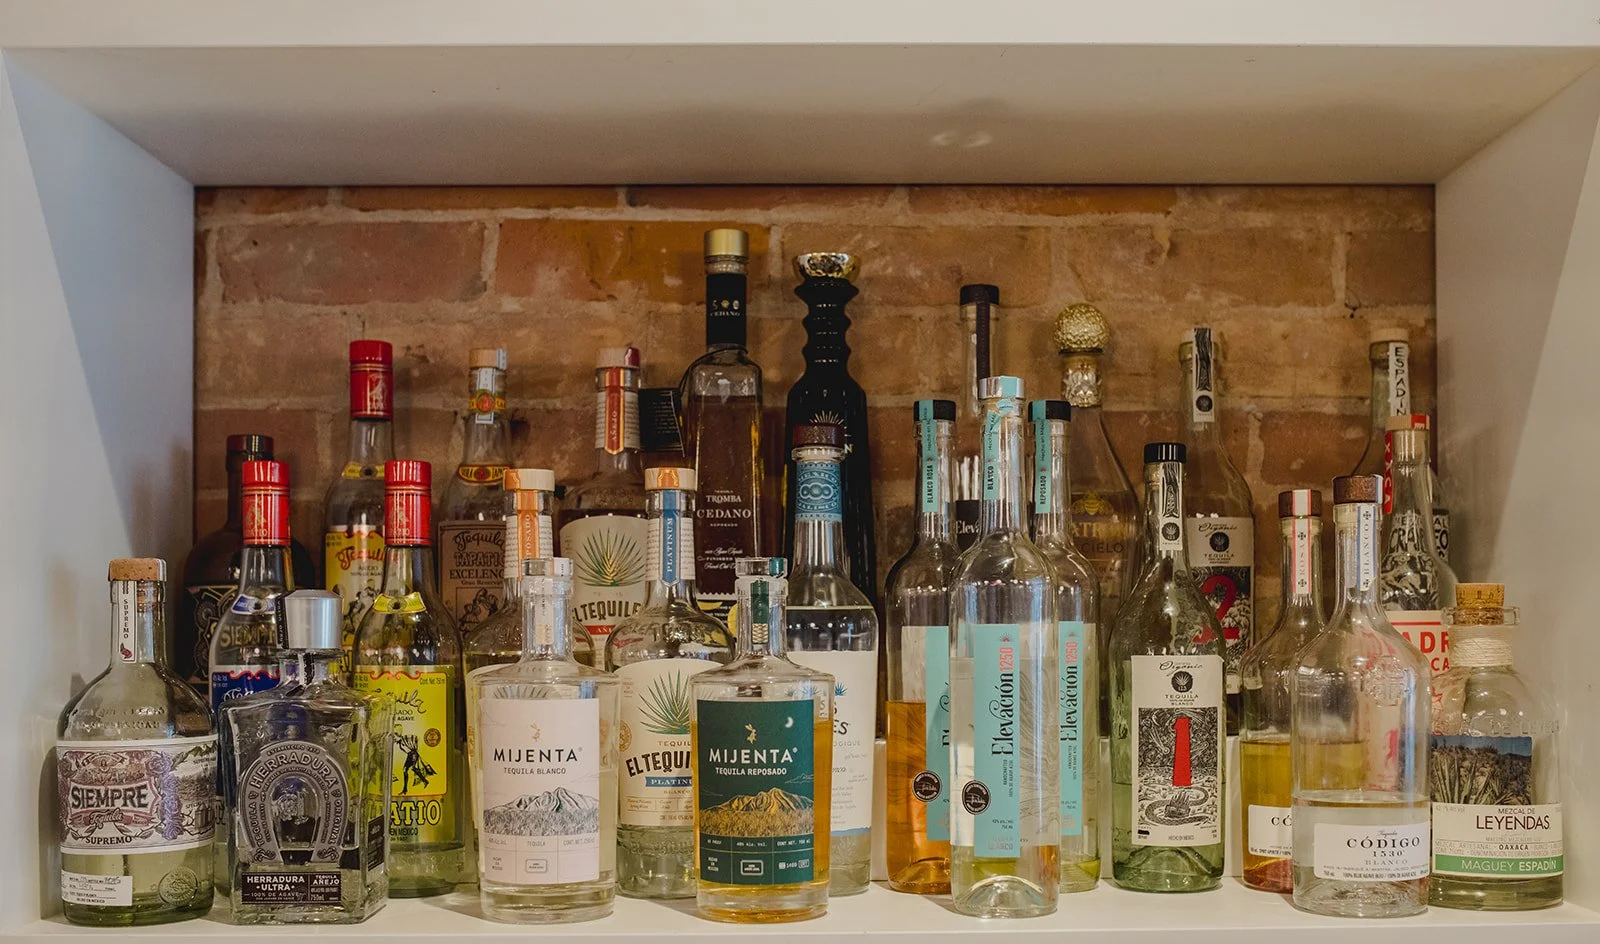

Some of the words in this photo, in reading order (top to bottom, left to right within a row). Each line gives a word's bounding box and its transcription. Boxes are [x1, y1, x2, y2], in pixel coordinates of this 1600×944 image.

[705, 494, 742, 504] TROMBA
[696, 508, 752, 519] CEDANO
[452, 530, 506, 552] Tequila
[1082, 542, 1124, 553] CIELO
[122, 598, 130, 640] SUPREMO
[1000, 646, 1014, 672] 1250
[1065, 641, 1078, 664] 1250
[1059, 665, 1078, 741] Elevación
[988, 673, 1014, 756] Elevación
[493, 748, 579, 763] MIJENTA
[708, 748, 794, 764] MIJENTA
[1172, 716, 1192, 787] 1
[249, 752, 339, 789] HERRADURA
[503, 767, 535, 775] TEQUILA
[536, 767, 567, 775] BLANCO
[715, 767, 746, 776] TEQUILA
[747, 767, 788, 776] REPOSADO
[71, 784, 149, 810] SIEMPRE
[88, 807, 124, 829] Tequila
[1498, 807, 1526, 815] MEZCAL
[1527, 807, 1537, 815] DE
[248, 802, 265, 847] TEQUILA
[327, 799, 343, 845] ORIGINAL
[1476, 814, 1551, 830] LEYENDAS
[85, 835, 133, 845] SUPREMO
[1346, 836, 1421, 849] CÓDIGO
[1373, 850, 1404, 858] 1530
[1461, 859, 1515, 872] MAGUEY
[246, 875, 306, 884] HERRADURA
